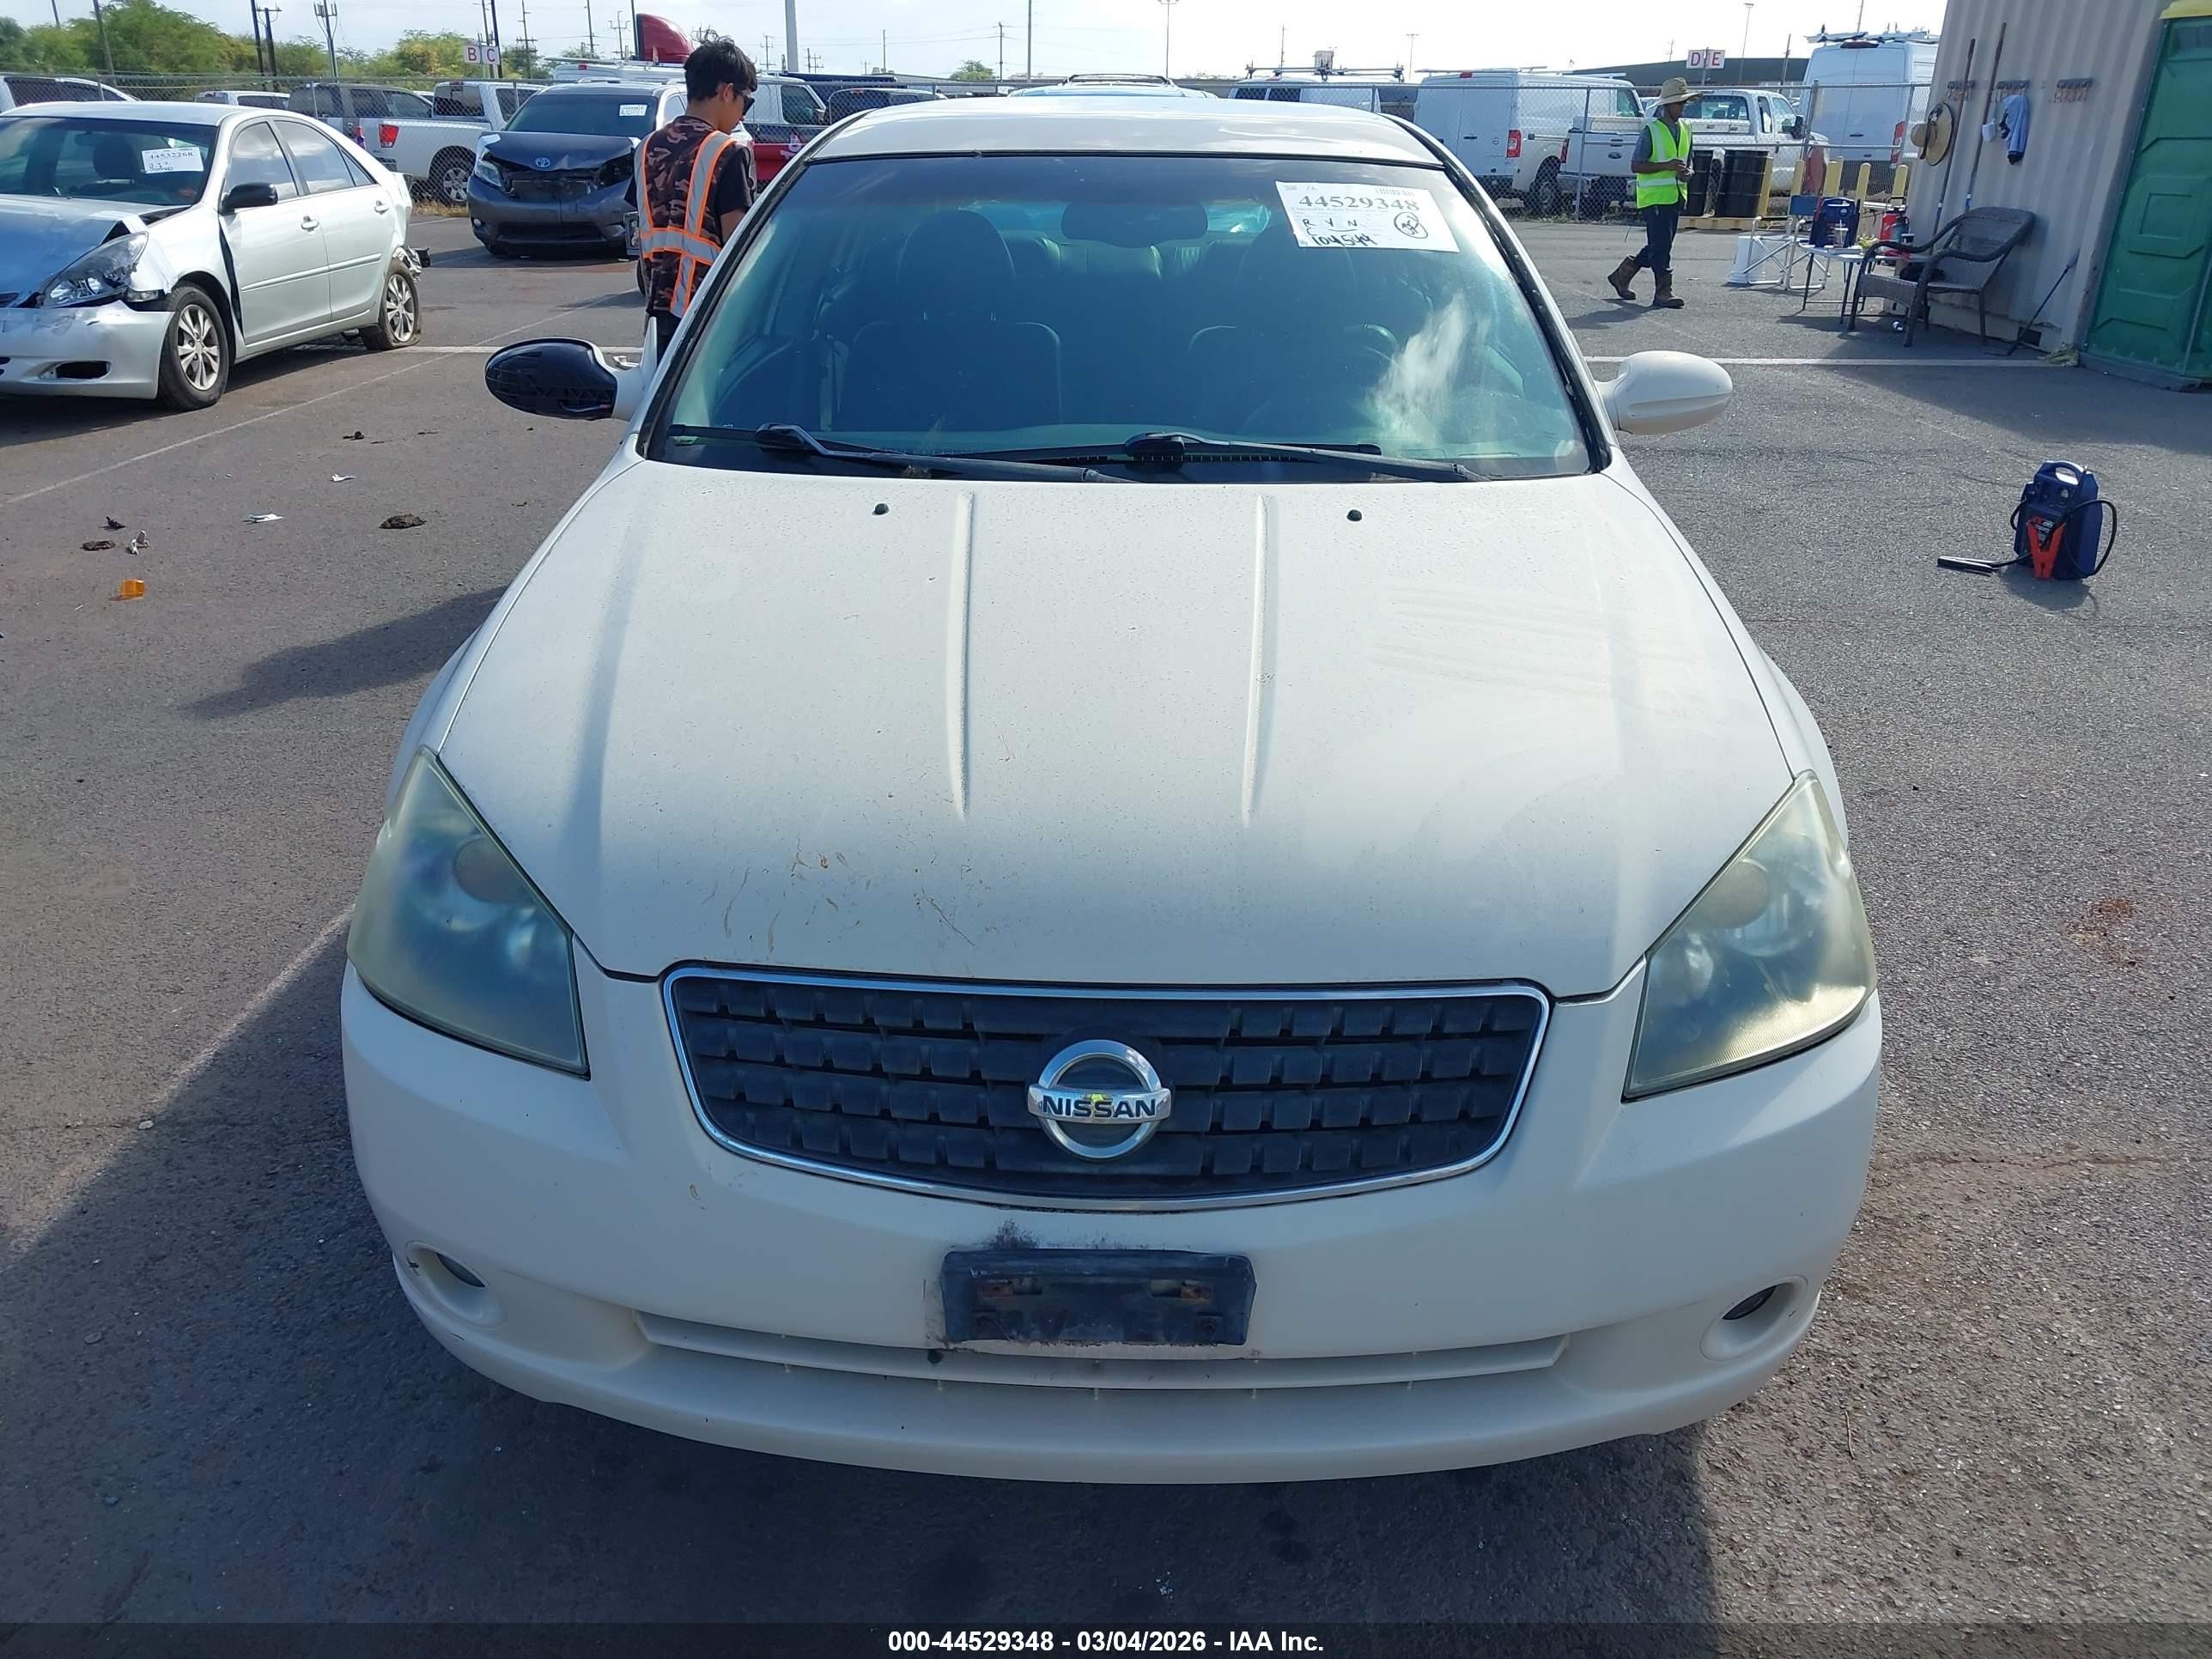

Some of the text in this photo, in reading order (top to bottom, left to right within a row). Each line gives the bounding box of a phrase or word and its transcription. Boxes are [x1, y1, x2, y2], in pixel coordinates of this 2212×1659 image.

[468, 47, 495, 62] B C
[1691, 52, 1721, 66] D E
[1299, 195, 1419, 211] 44529348
[1042, 1095, 1156, 1117] NISSAN
